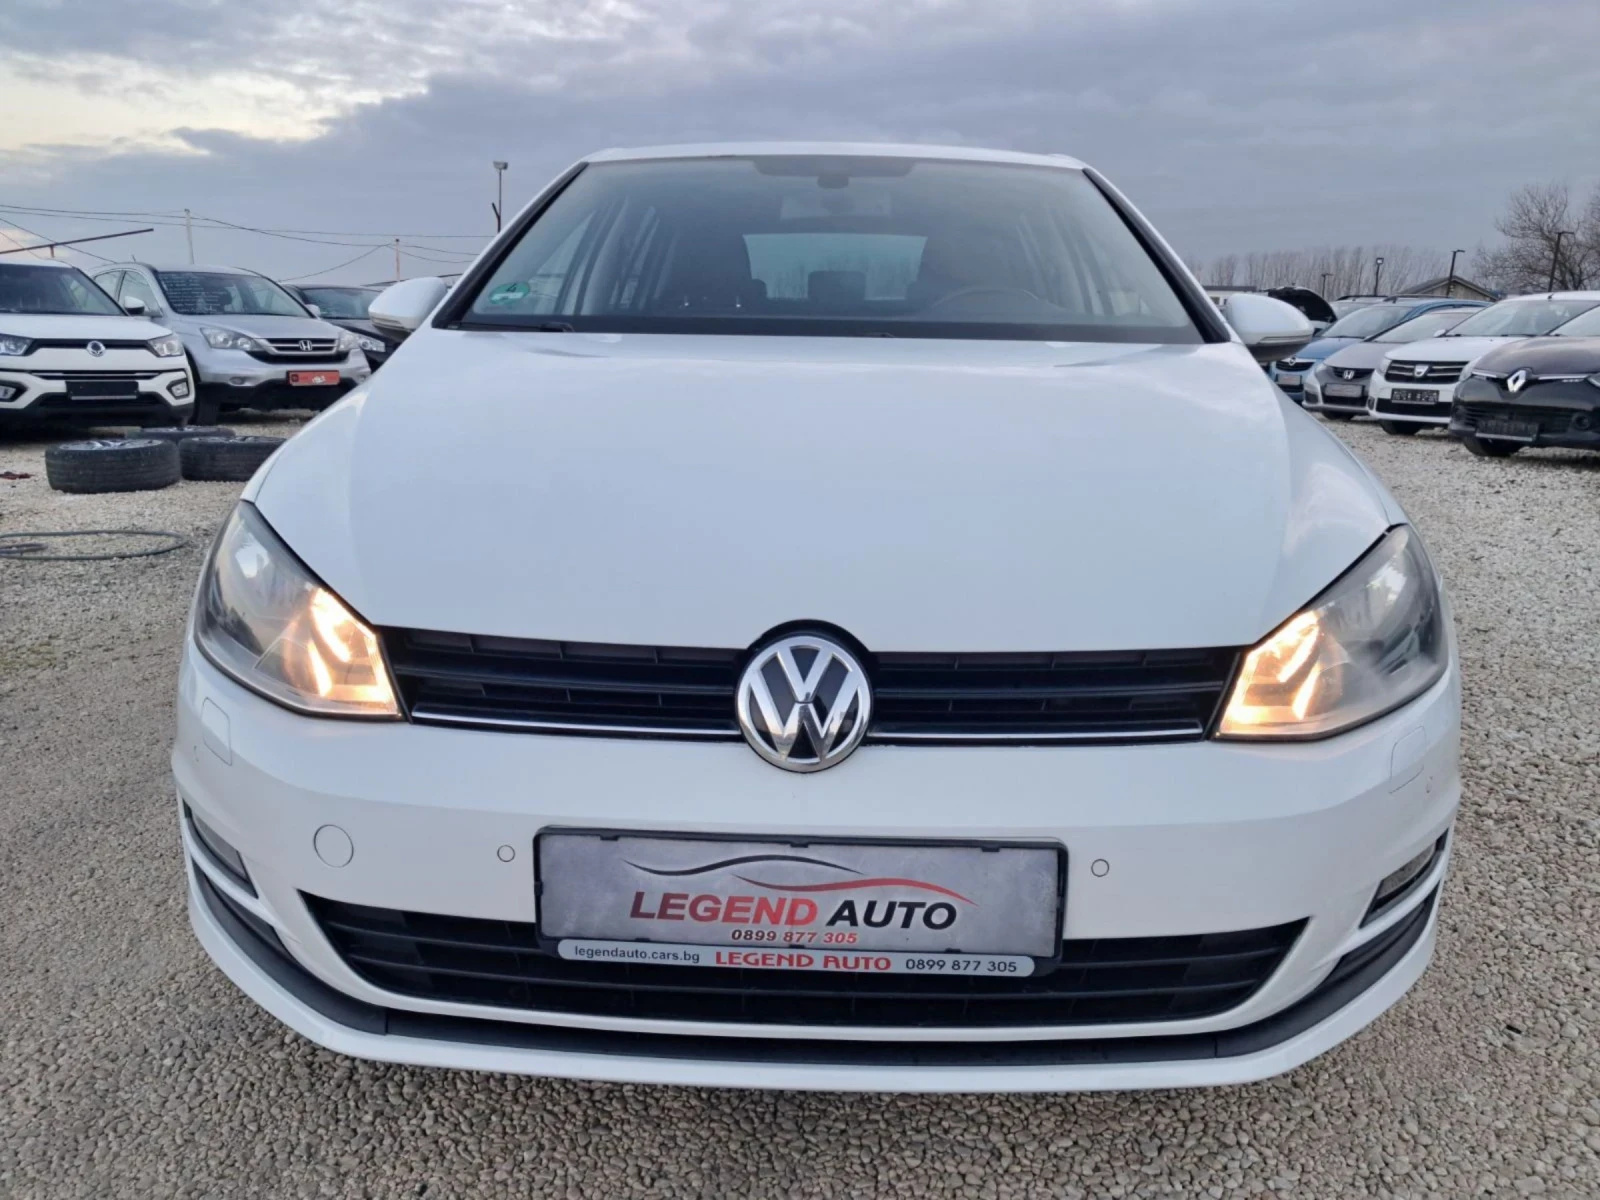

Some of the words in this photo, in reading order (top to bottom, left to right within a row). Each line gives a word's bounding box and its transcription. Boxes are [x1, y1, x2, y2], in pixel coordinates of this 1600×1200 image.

[630, 891, 818, 926] LEGEND
[825, 899, 957, 930] AUTO
[731, 929, 777, 942] 0899
[783, 931, 817, 943] 877
[823, 932, 857, 944] 305
[574, 945, 701, 964] legendauto.cars.bg
[715, 951, 815, 968] LEGEND
[823, 955, 892, 971] AUTO
[905, 958, 946, 970] 0899
[951, 960, 982, 972] 877
[986, 961, 1018, 973] 305
